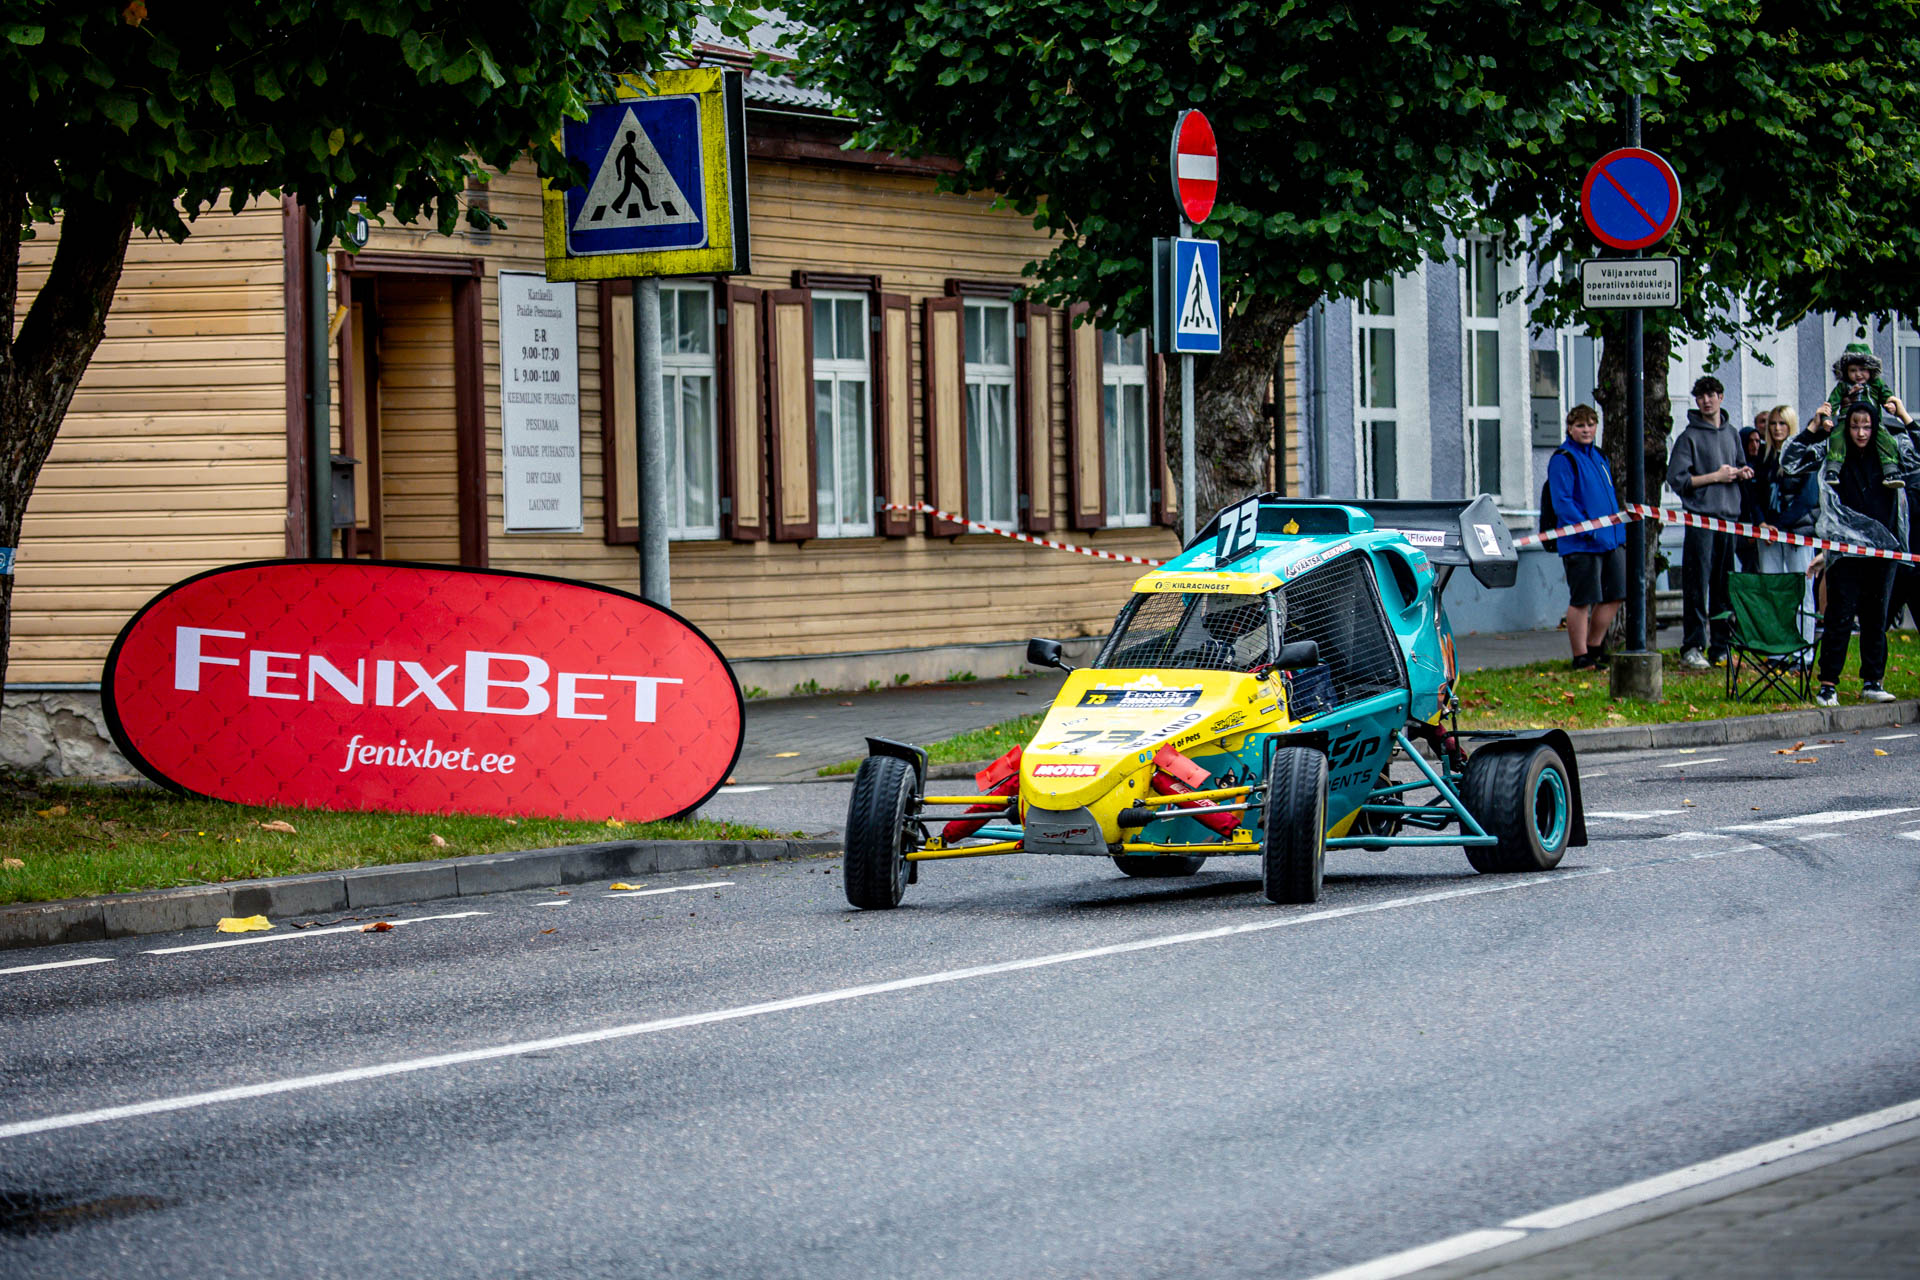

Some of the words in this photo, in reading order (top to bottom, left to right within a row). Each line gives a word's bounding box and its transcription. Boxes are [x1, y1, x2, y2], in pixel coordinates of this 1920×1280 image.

[1601, 269, 1623, 279] Välja
[1624, 268, 1657, 277] arvatud
[1664, 280, 1672, 290] ja
[1632, 291, 1670, 300] sõidukid
[516, 304, 533, 317] Paide
[534, 305, 562, 319] Pesumaja
[534, 328, 547, 342] E-R
[514, 368, 519, 381] L
[507, 391, 542, 404] KEEMILINE
[543, 393, 576, 405] PUHASTUS
[526, 418, 559, 432] PESUMAJA
[511, 444, 540, 457] VAIPADE
[541, 445, 575, 458] PUHASTUS
[526, 471, 539, 484] DRY
[540, 471, 561, 484] CLEAN
[529, 498, 560, 511] LAUNDRY
[1219, 497, 1259, 559] 73
[1086, 694, 1109, 705] 73
[1060, 730, 1146, 744] 73
[1185, 732, 1201, 744] Pets
[339, 734, 516, 775] fenixbet.ee
[1034, 765, 1097, 776] MOTUL
